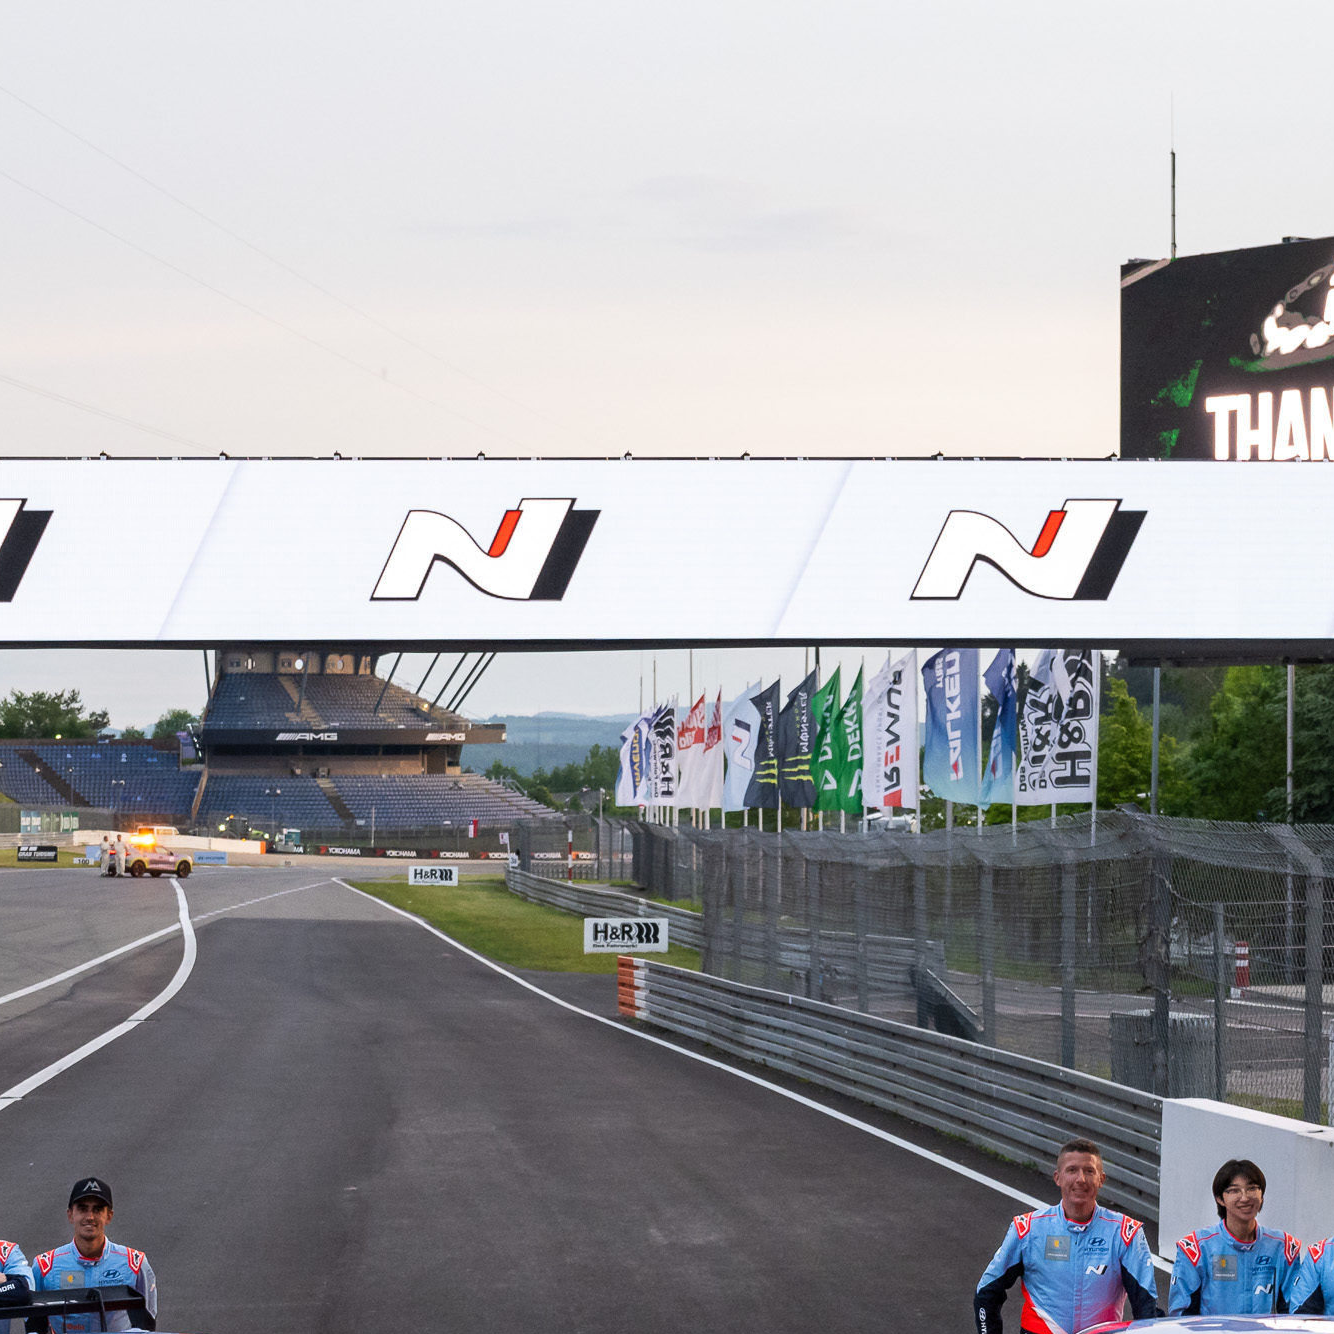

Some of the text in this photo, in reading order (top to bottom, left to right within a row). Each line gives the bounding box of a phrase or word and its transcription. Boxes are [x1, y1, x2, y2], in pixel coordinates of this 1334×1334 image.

[439, 732, 466, 741] AMG
[328, 846, 361, 856] YOKOHAMA
[385, 850, 417, 858] YOKOHAMA
[439, 851, 470, 859] YOKOHAMA
